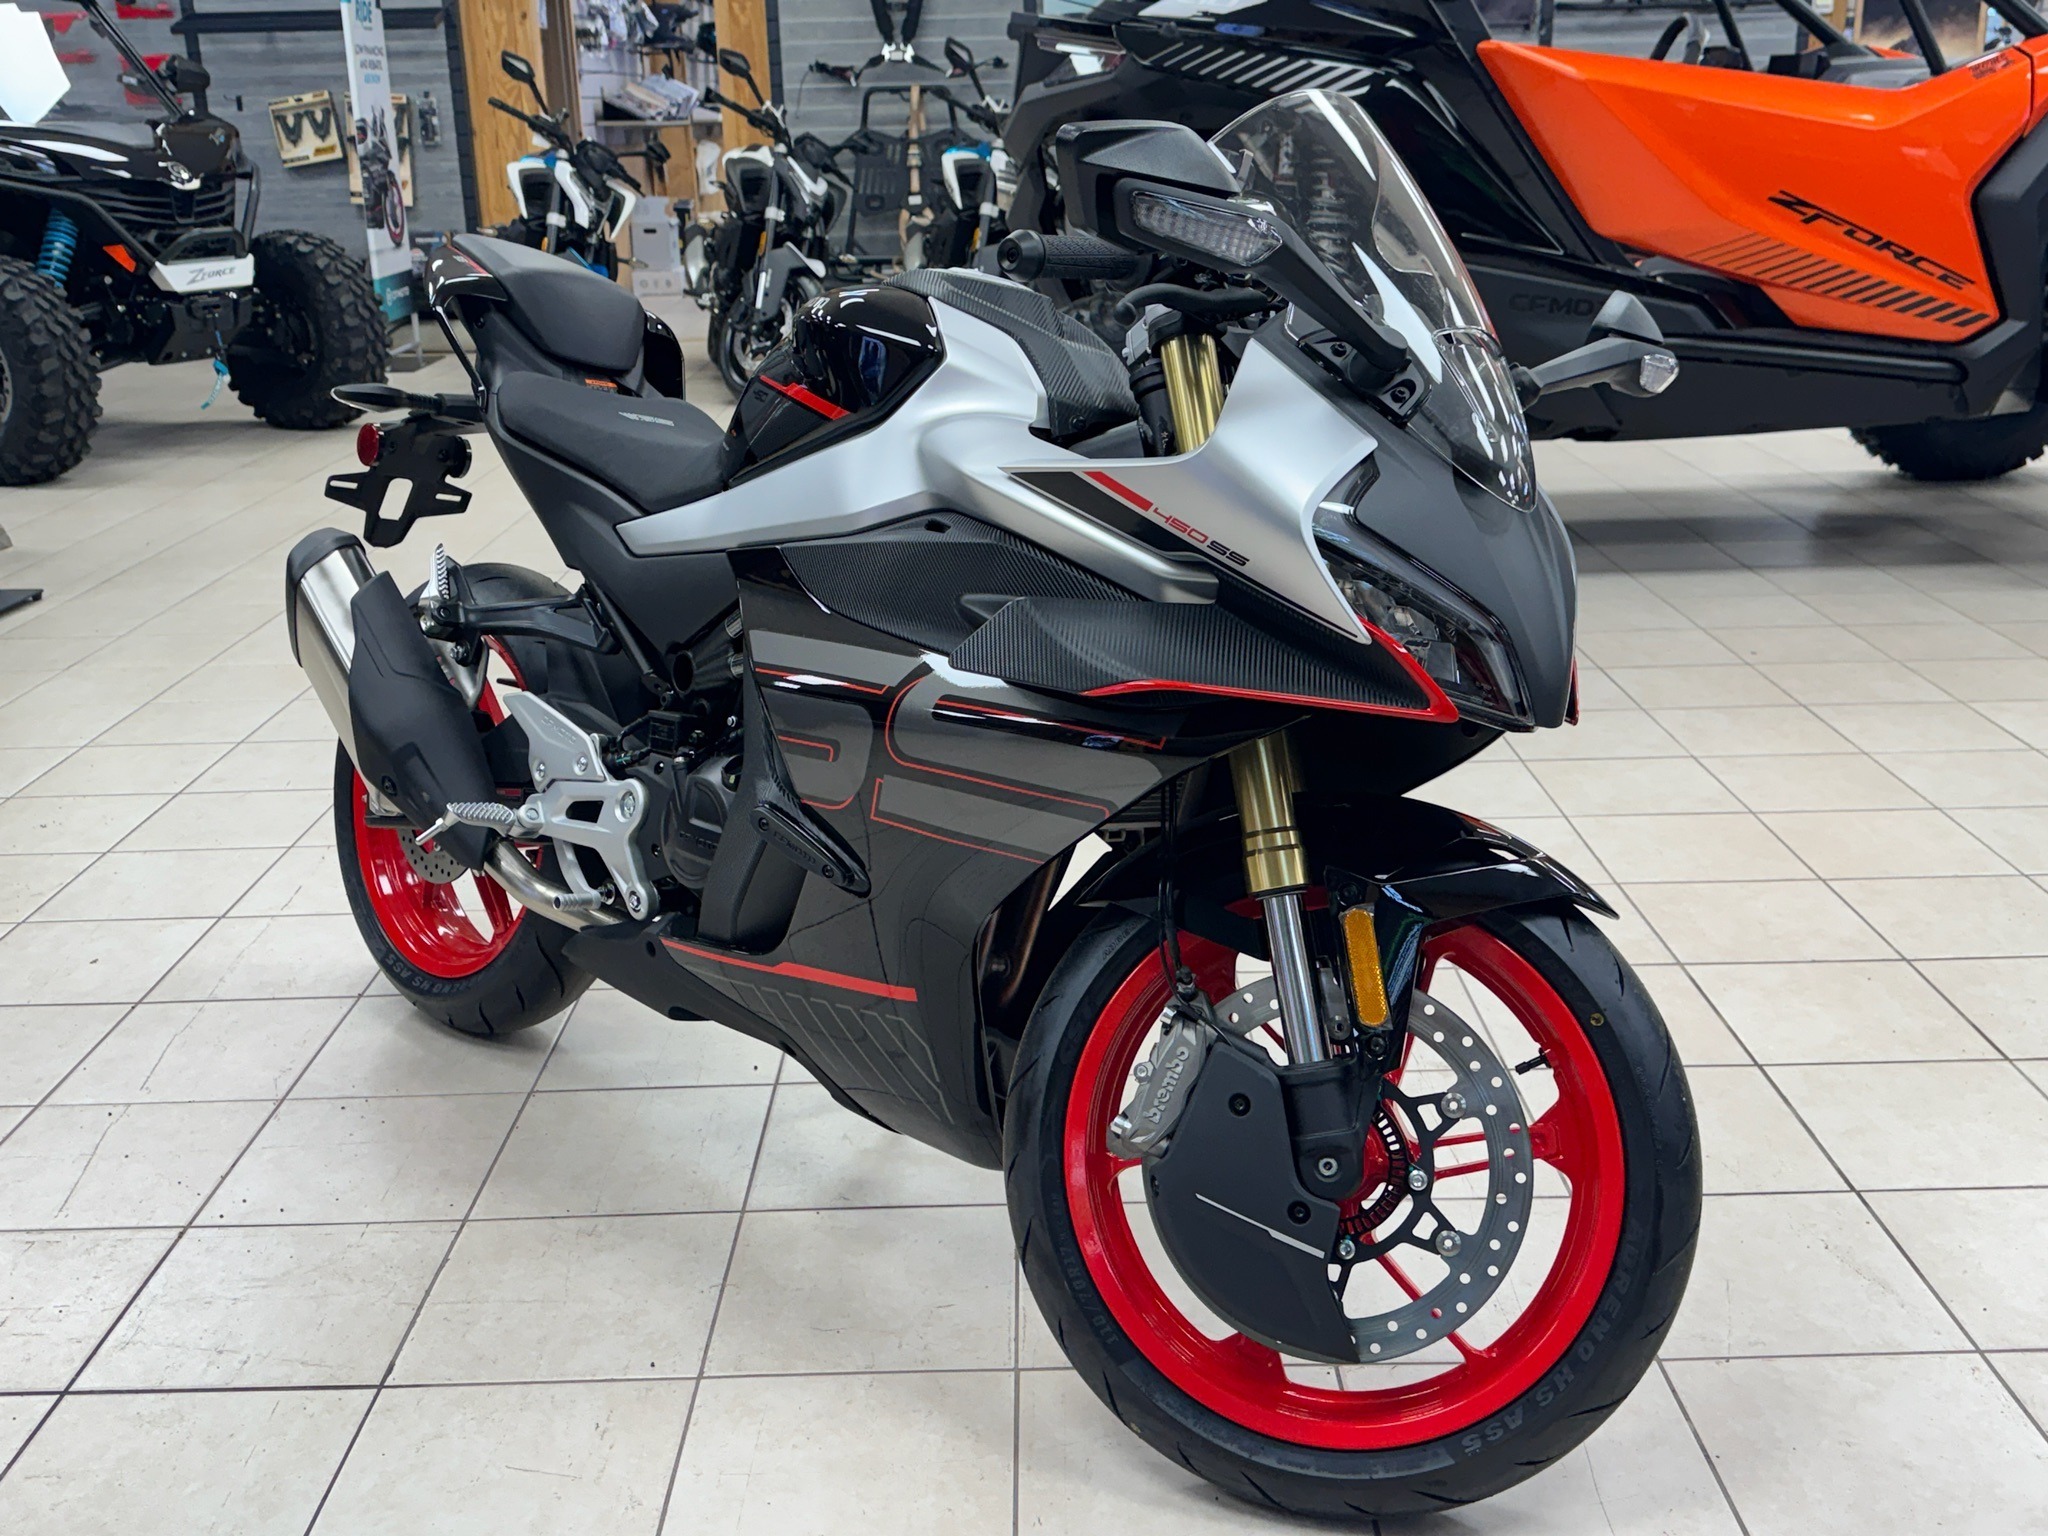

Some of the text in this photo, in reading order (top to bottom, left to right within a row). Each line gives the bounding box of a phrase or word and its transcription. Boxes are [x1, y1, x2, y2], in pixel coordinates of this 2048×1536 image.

[1768, 189, 1976, 290] ZFORCE
[186, 266, 236, 286] ZFORCE
[1508, 293, 1598, 317] CFMO
[1143, 1046, 1189, 1124] brembo
[1536, 1364, 1577, 1409] HS
